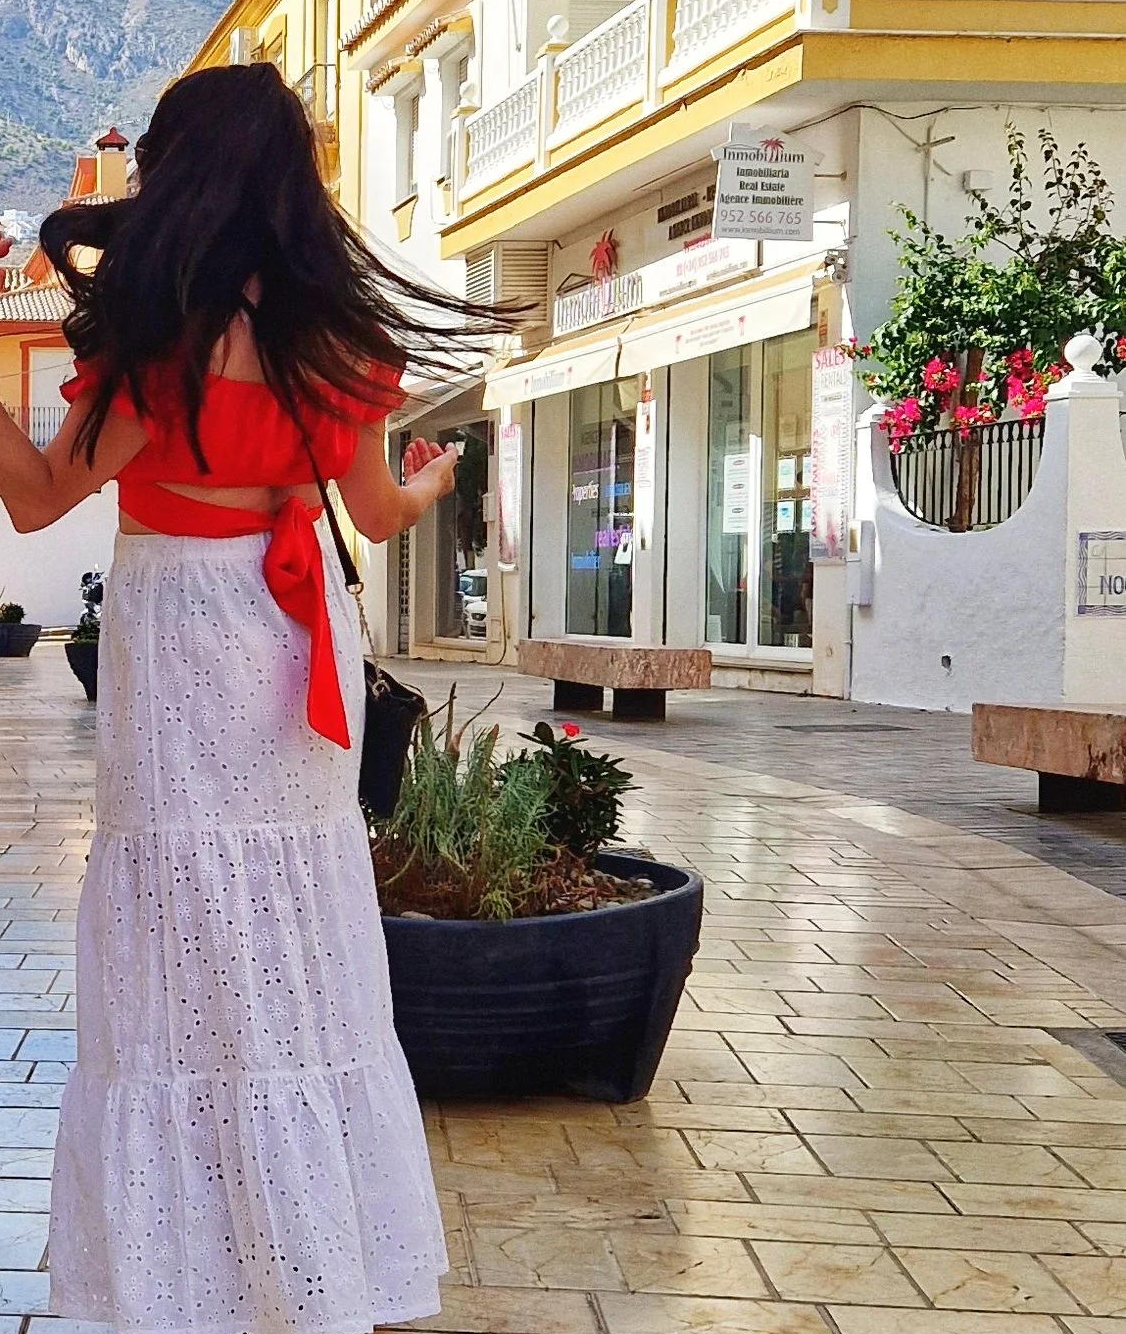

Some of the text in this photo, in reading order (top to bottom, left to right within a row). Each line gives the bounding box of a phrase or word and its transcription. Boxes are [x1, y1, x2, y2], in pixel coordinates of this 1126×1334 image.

[736, 167, 790, 179] Inmobiliaria
[739, 181, 786, 192] Real Estate
[719, 193, 750, 205] Agence
[720, 209, 802, 225] 952 566 765
[1099, 575, 1126, 596] NO
